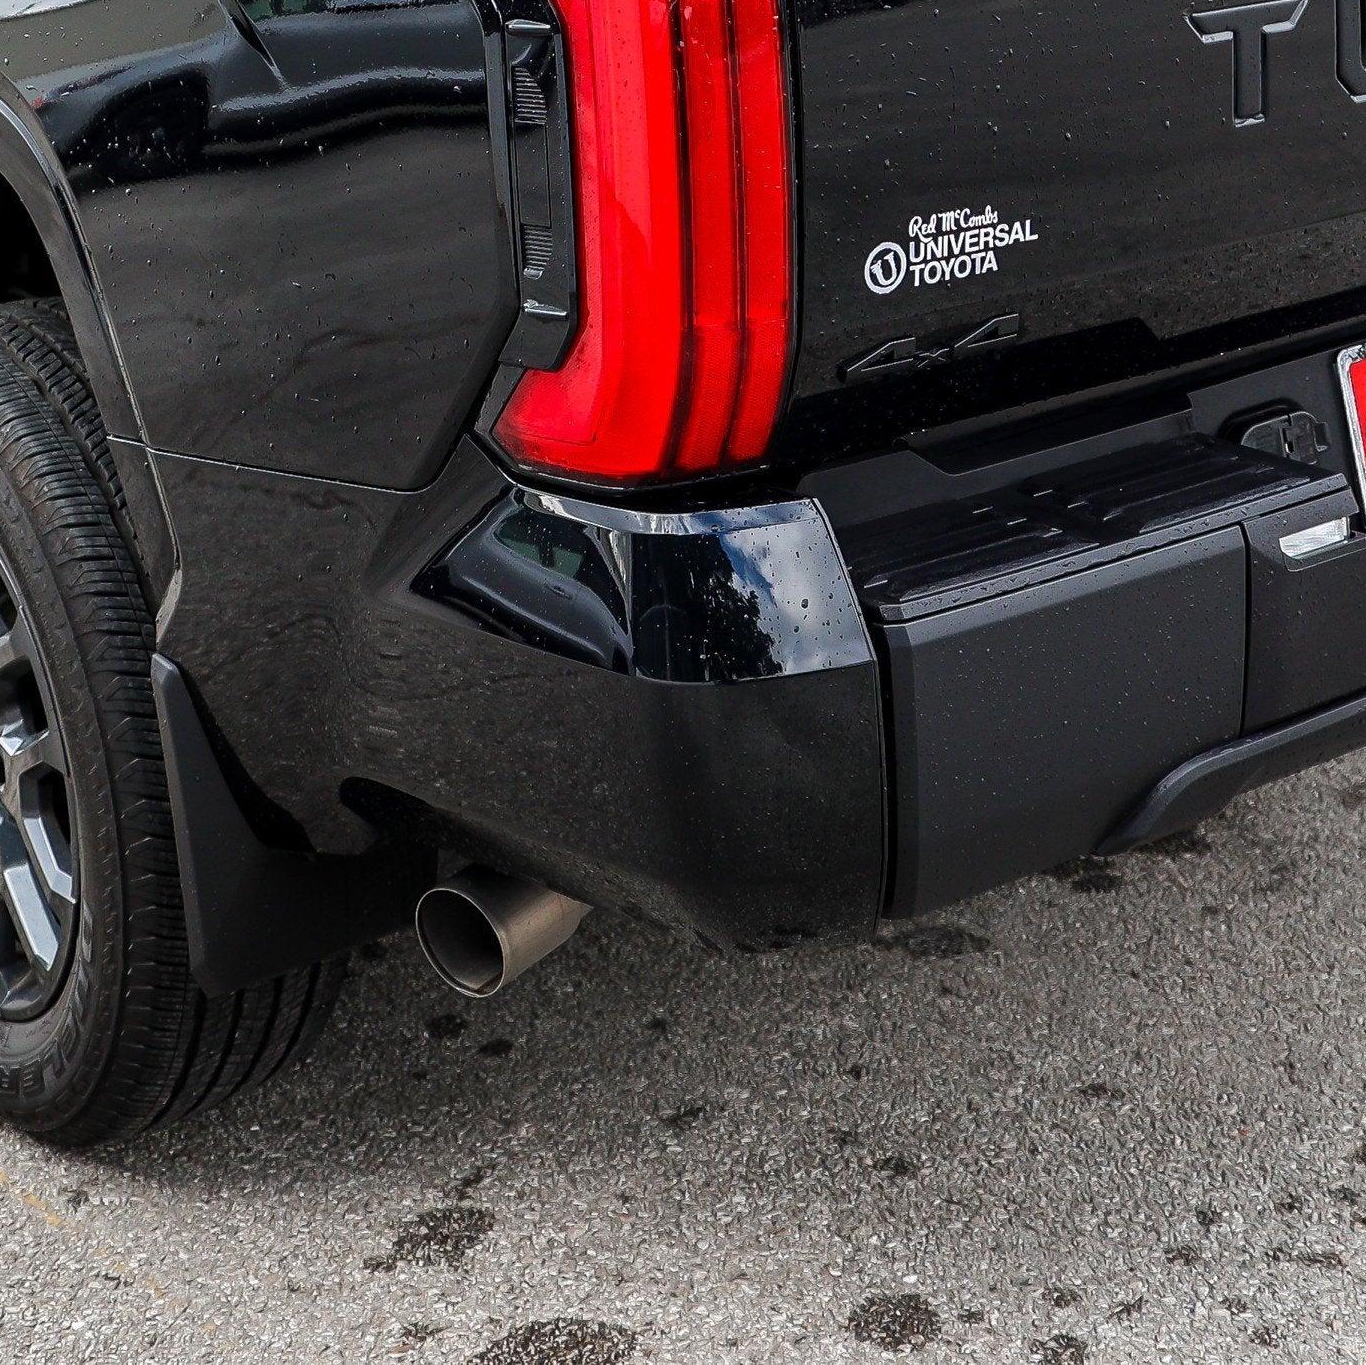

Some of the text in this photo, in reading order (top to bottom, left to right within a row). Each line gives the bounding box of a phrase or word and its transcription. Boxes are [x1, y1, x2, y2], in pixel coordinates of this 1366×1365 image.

[908, 204, 999, 243] Red McCombs
[909, 220, 1039, 263] UNIVERSAL
[909, 251, 999, 287] TOYOTA
